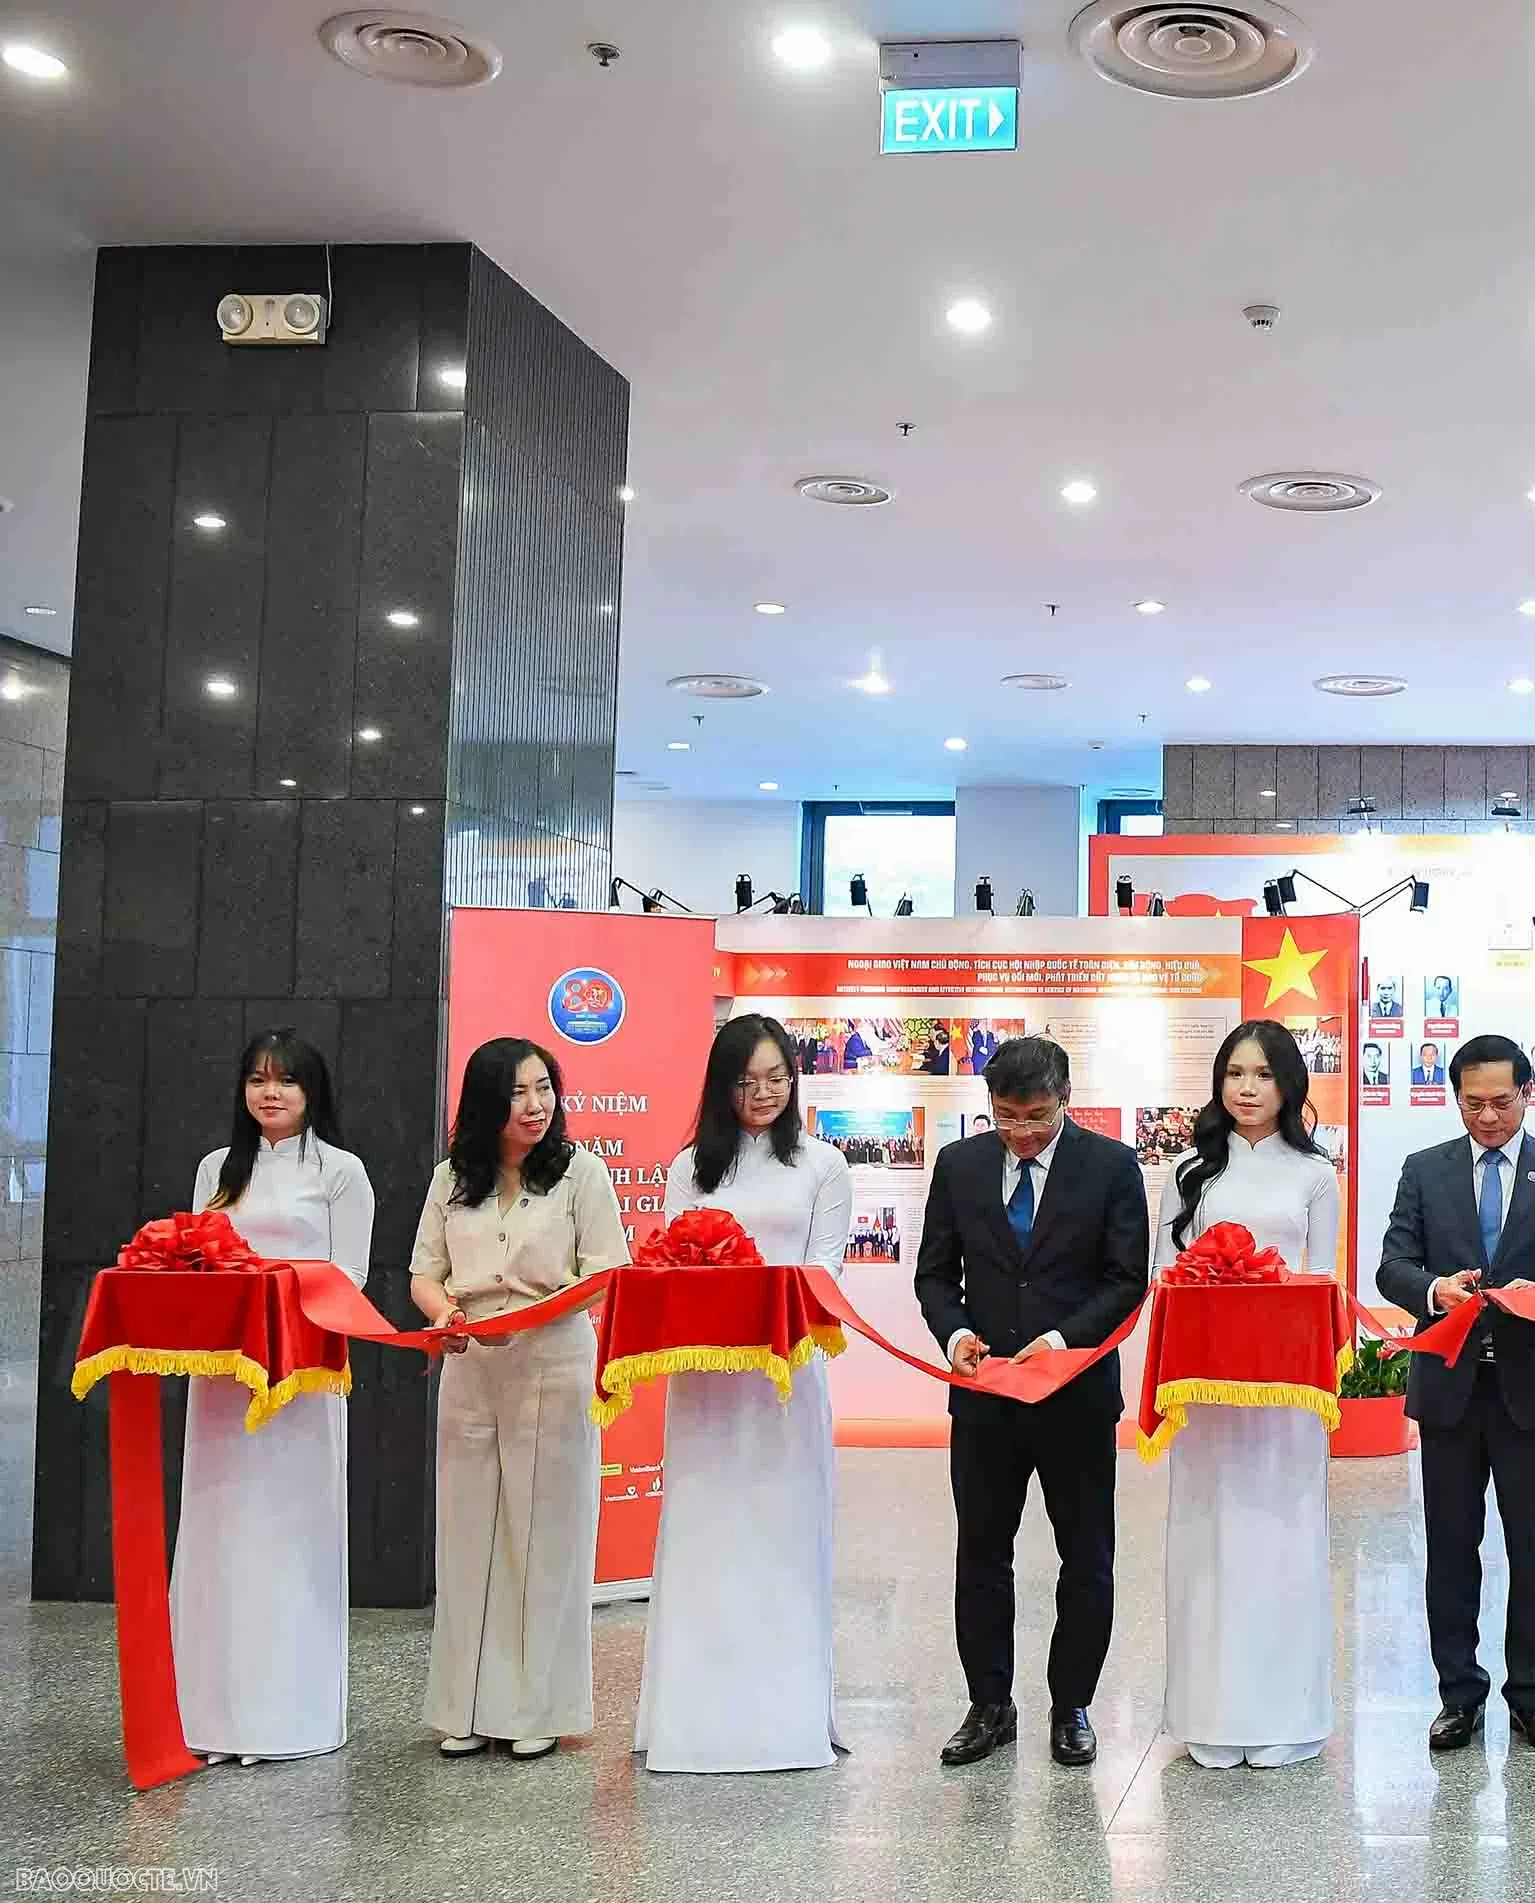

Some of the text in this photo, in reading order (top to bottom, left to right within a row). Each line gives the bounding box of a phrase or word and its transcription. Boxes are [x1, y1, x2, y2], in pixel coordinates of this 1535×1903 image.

[895, 99, 981, 142] EXIT
[893, 958, 910, 972] VIỆT
[911, 959, 930, 969] NAM
[592, 1091, 648, 1117] NIỆM
[574, 1136, 624, 1157] NĂM
